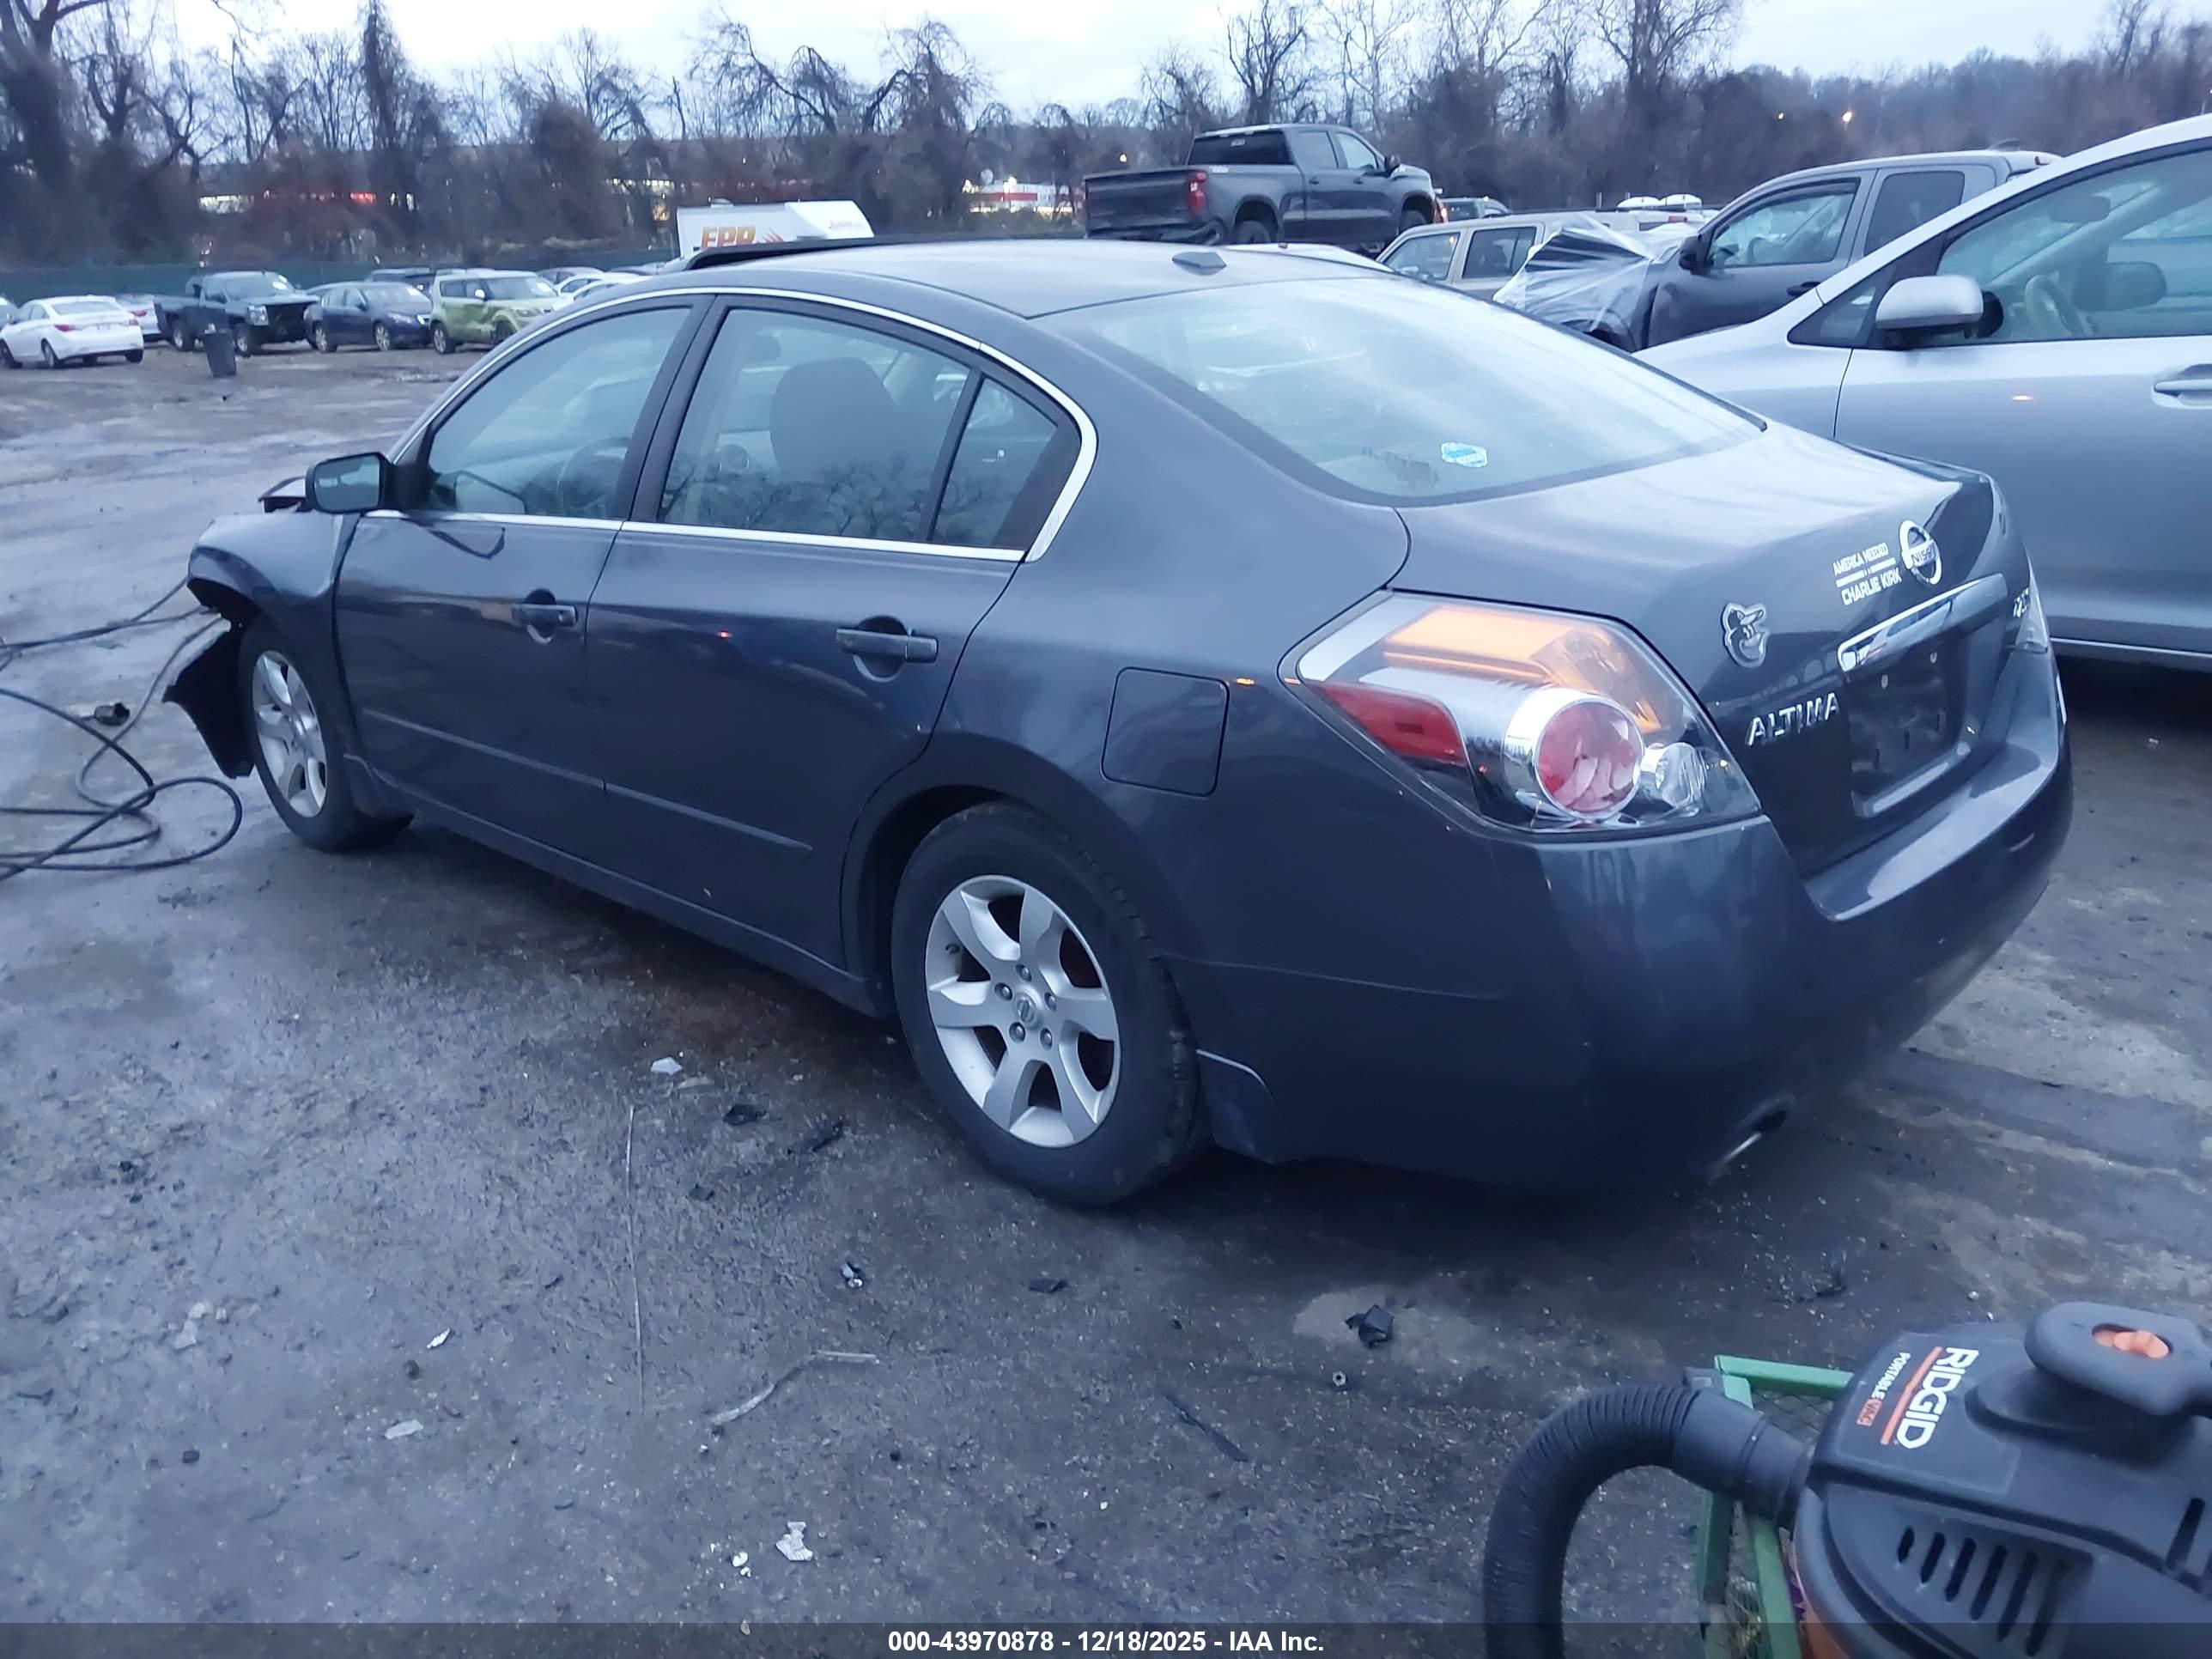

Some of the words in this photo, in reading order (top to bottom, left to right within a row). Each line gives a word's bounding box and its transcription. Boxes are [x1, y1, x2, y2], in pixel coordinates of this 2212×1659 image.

[1832, 552, 1863, 576] AMERICA
[1841, 580, 1881, 605] CHARLIE
[1881, 568, 1903, 589] KIRK
[1747, 692, 1840, 746] ALTIMA
[1857, 1400, 1881, 1425] VAC
[1897, 1346, 1979, 1449] RIDGID
